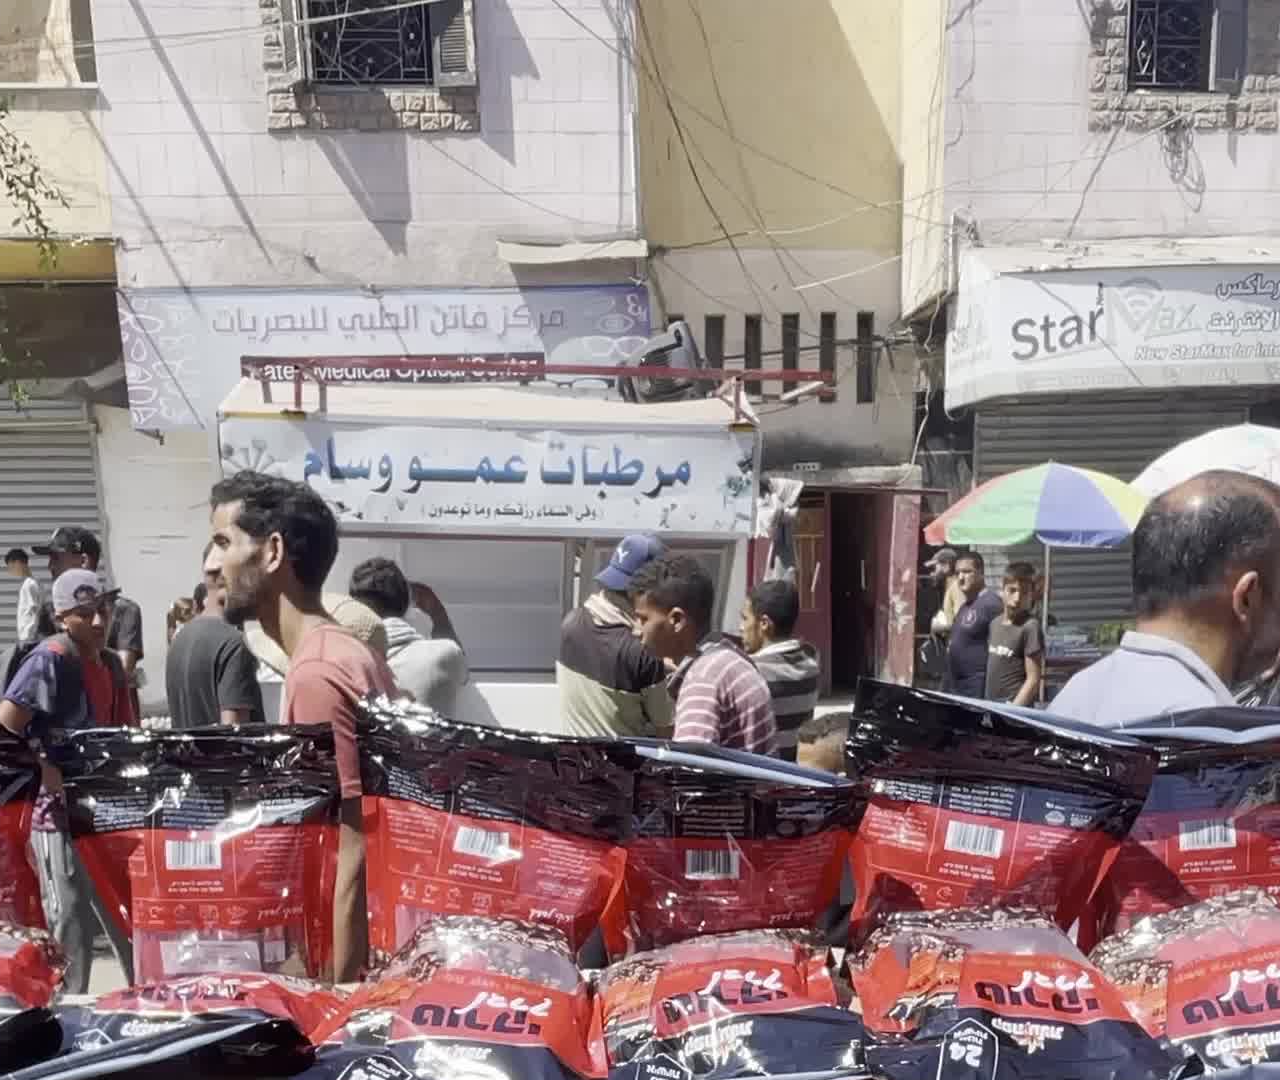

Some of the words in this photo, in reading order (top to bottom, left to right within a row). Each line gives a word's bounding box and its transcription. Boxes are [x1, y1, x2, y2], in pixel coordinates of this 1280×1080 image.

[212, 305, 328, 343] للبصريات
[337, 303, 419, 337] الطبي
[430, 303, 488, 337] فاتن
[501, 304, 567, 336] مركز
[1011, 306, 1102, 361] Star
[304, 436, 393, 495] وسام
[540, 440, 692, 499] مرطبات
[974, 980, 1101, 1014] טורקי
[410, 1001, 542, 1036] טורקי
[948, 1041, 984, 1069] 24
